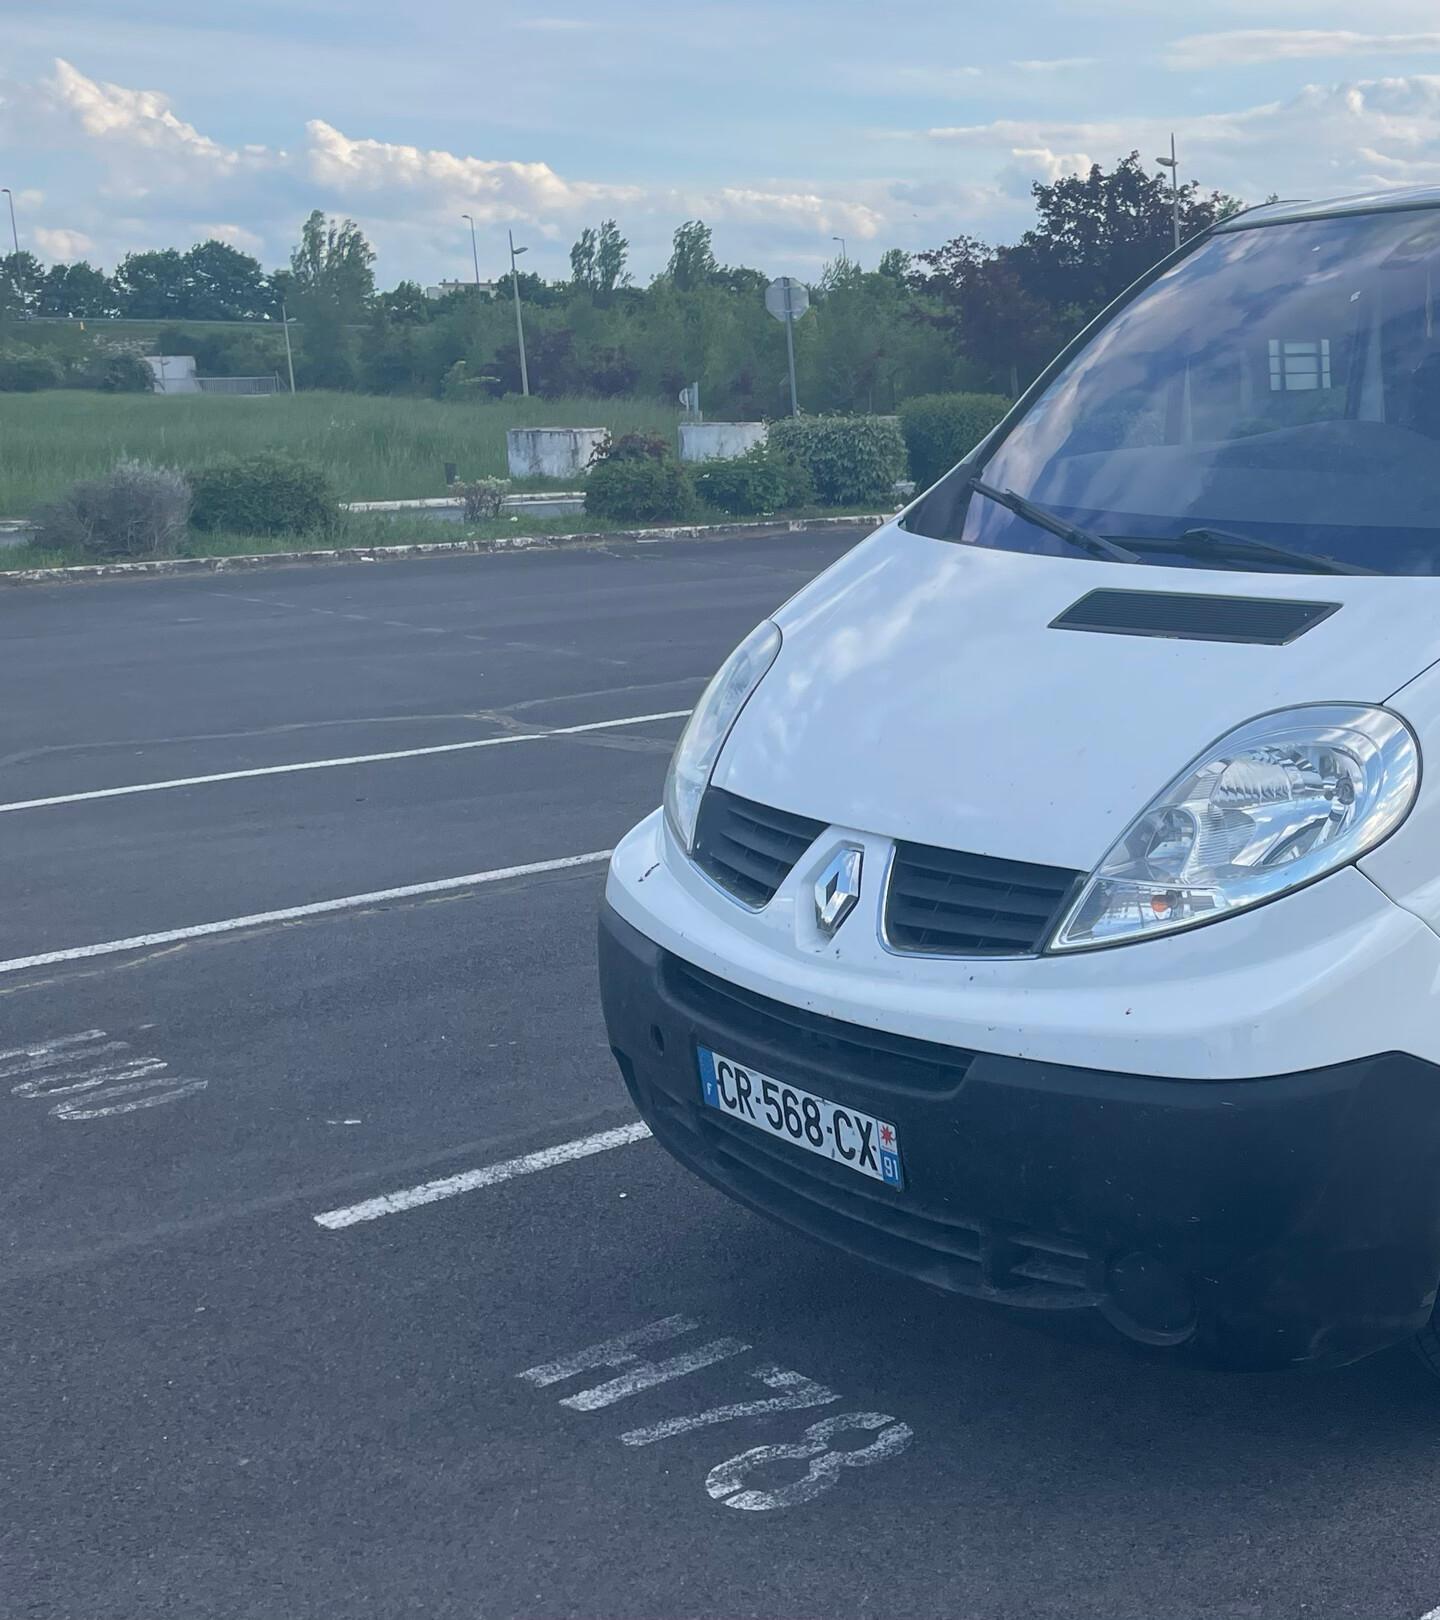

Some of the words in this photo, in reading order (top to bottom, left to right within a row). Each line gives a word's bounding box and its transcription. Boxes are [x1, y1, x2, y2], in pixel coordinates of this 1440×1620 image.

[718, 1061, 878, 1171] CR-568-CX
[884, 1156, 899, 1180] 91
[515, 1314, 914, 1511] H78
